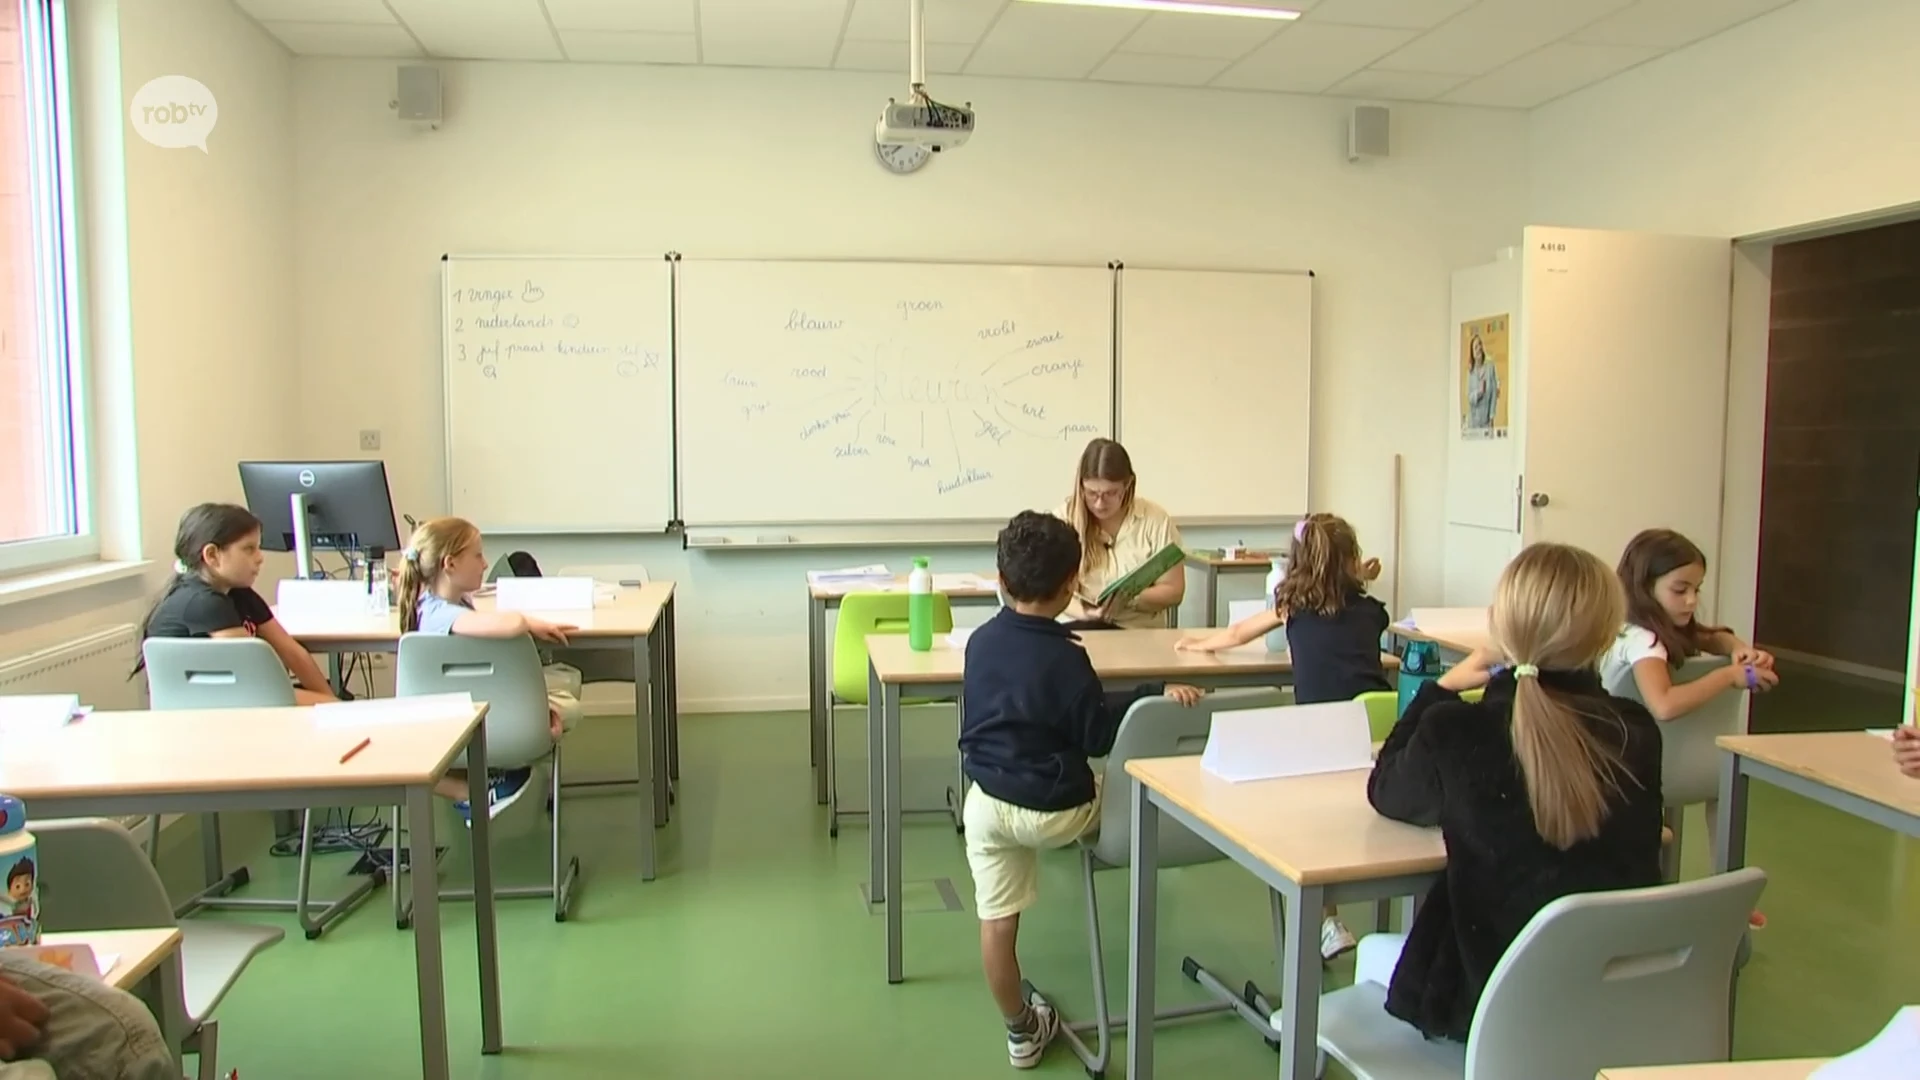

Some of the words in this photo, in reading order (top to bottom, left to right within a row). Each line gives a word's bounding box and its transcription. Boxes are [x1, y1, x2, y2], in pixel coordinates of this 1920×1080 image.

[453, 288, 463, 304] 1
[784, 308, 845, 331] blauw
[896, 300, 944, 321] groen
[454, 318, 465, 333] 2
[457, 343, 468, 362] 3
[790, 364, 828, 380] rood
[1031, 357, 1084, 380] oranje
[1058, 423, 1099, 441] paars
